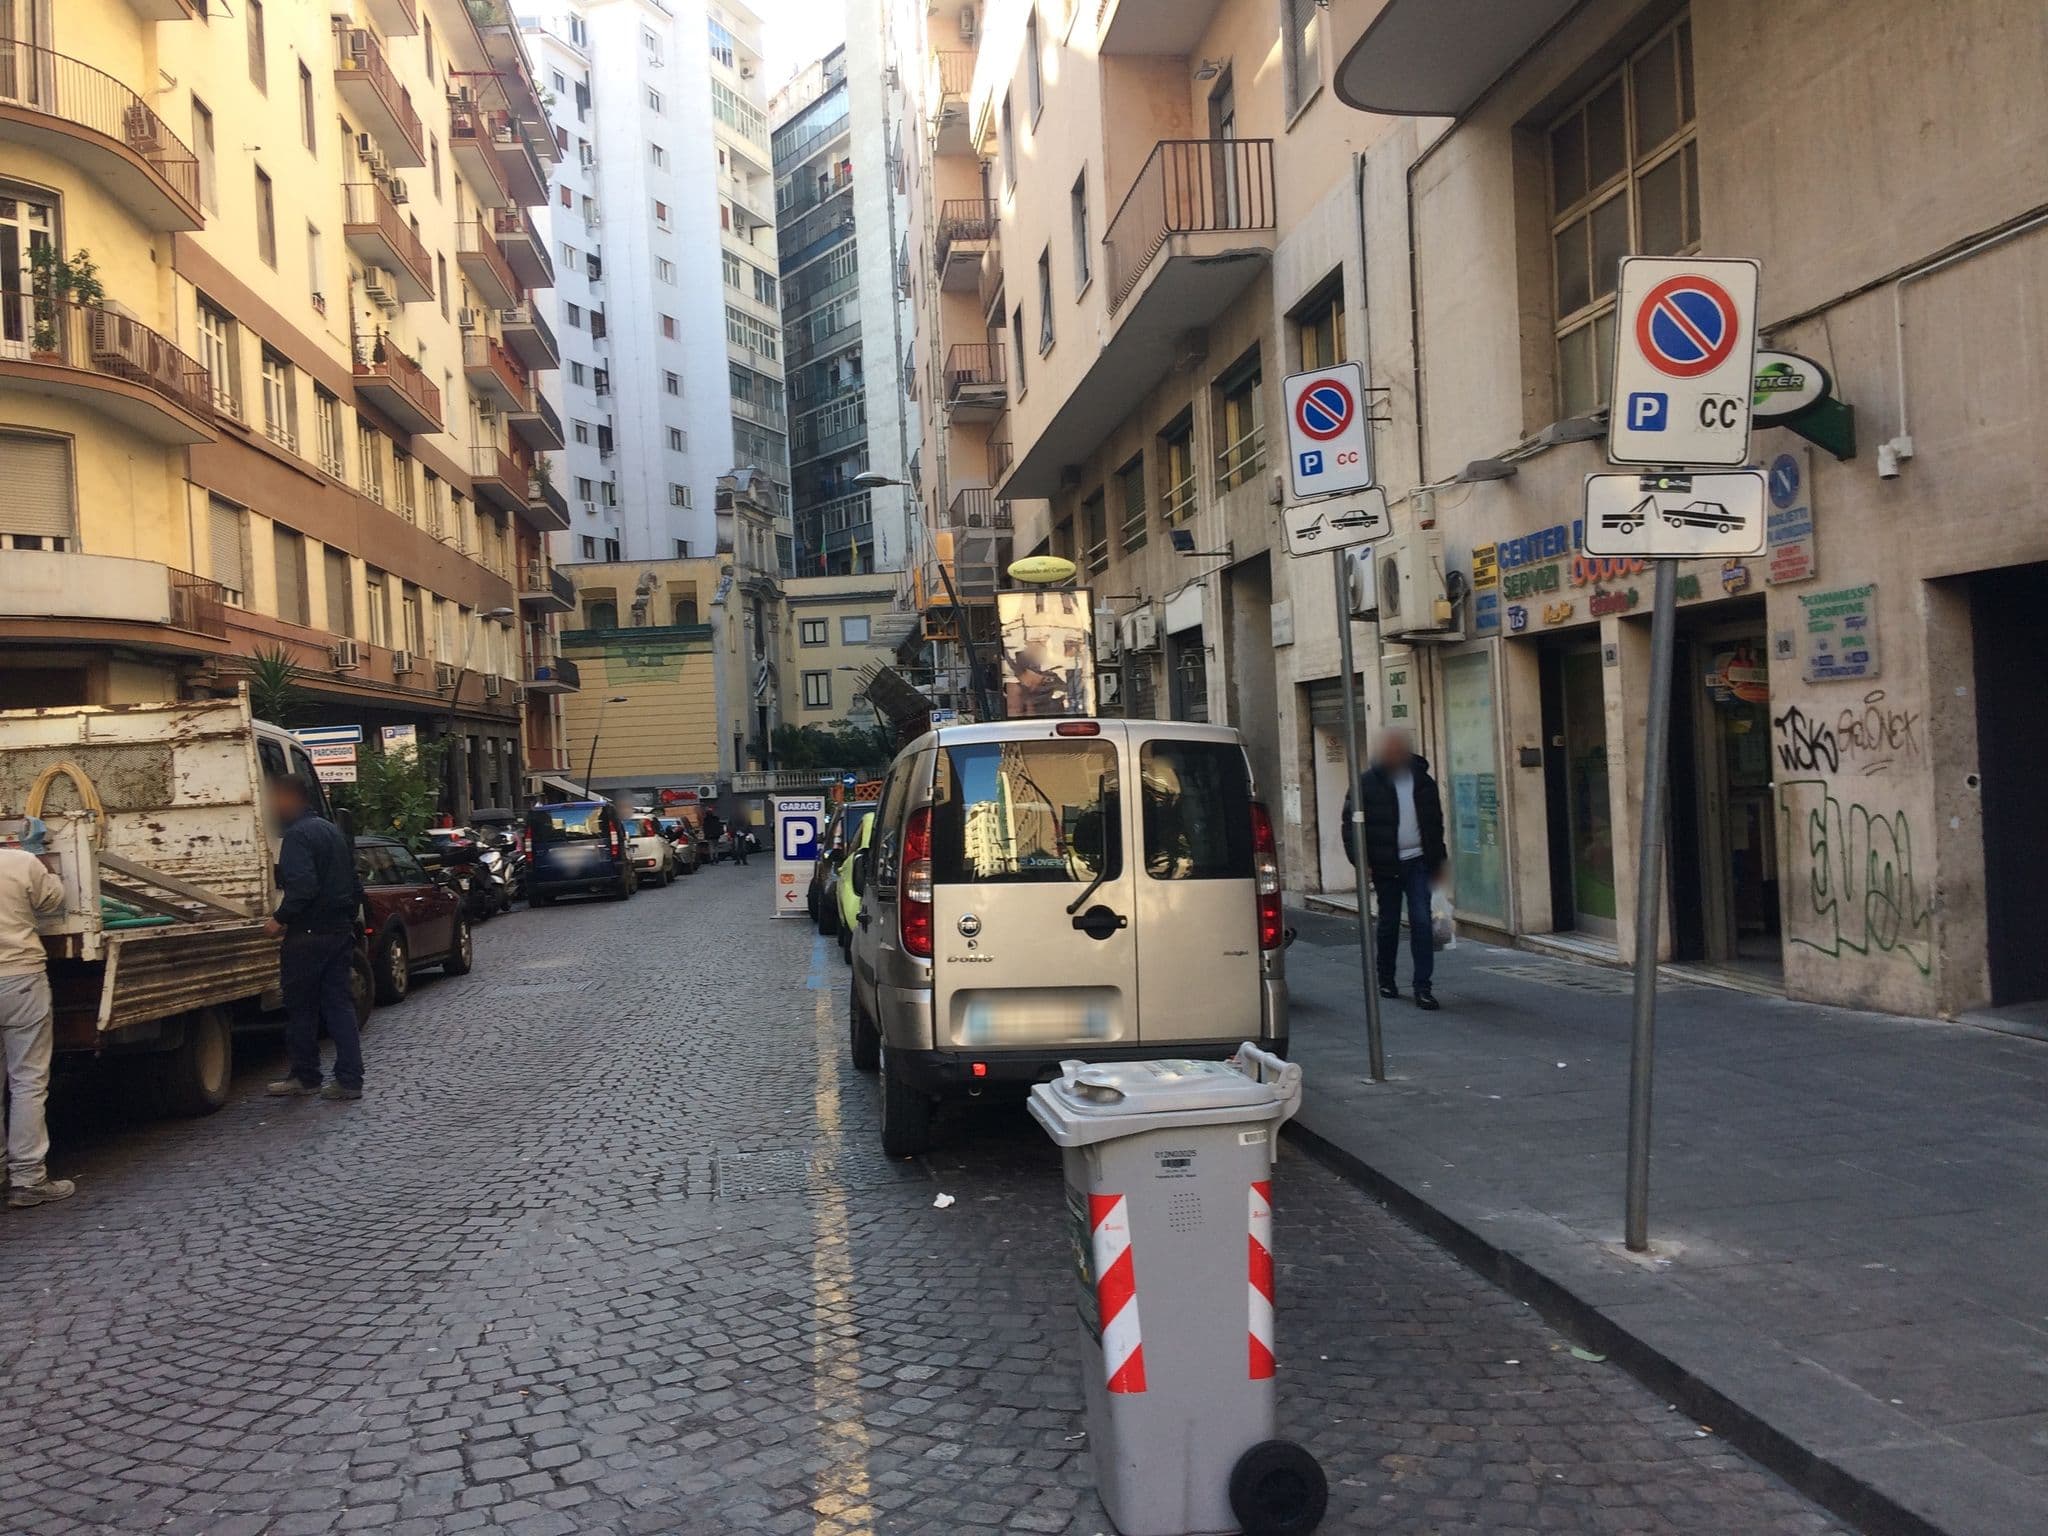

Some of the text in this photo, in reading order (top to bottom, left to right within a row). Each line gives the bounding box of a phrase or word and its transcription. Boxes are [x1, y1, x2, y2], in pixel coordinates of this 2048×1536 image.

[1754, 375, 1804, 388] TTER
[1635, 397, 1738, 429] P CC
[1304, 451, 1359, 473] P CC
[1499, 524, 1568, 570] CENTER
[1503, 563, 1560, 601] SERVIZI
[1801, 586, 1873, 606] SCOMMESSE
[1808, 602, 1864, 618] SPORTIVE
[780, 802, 819, 811] GARAGE
[786, 820, 814, 856] P
